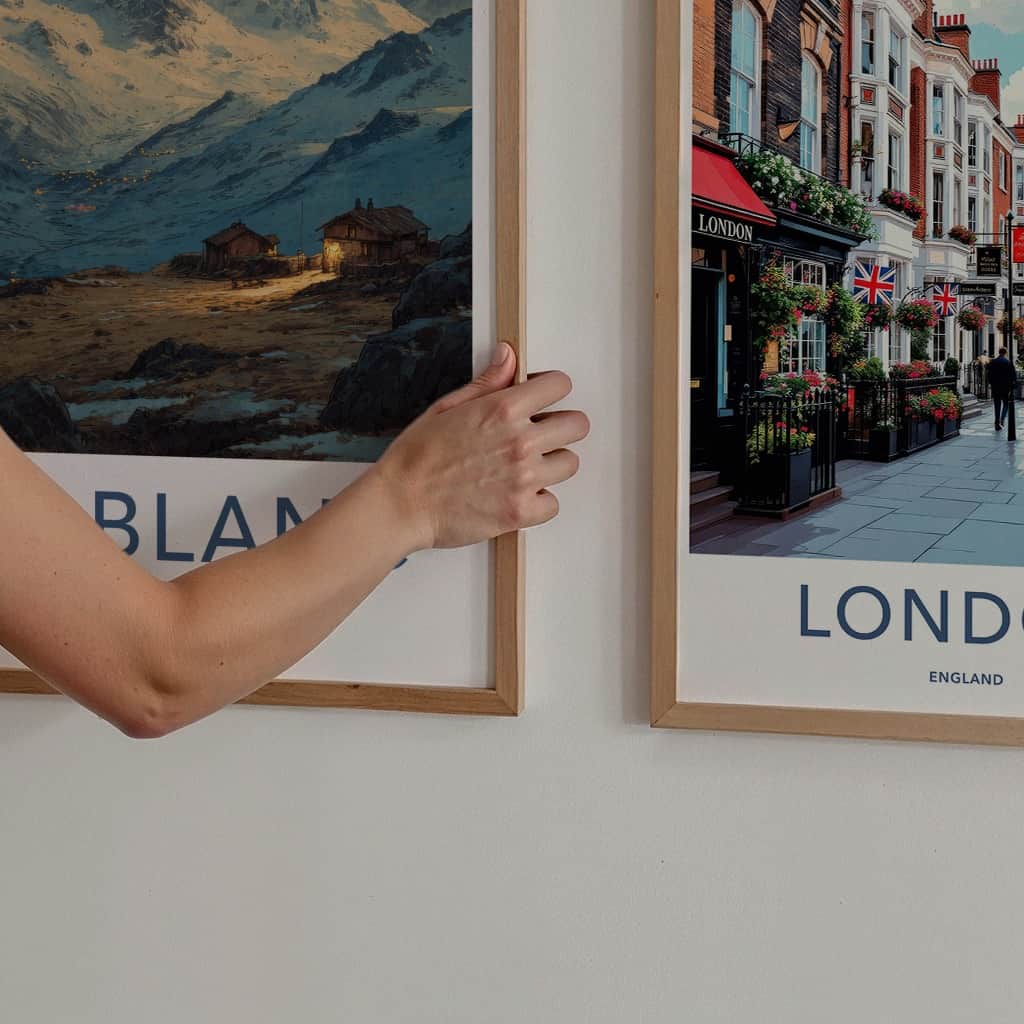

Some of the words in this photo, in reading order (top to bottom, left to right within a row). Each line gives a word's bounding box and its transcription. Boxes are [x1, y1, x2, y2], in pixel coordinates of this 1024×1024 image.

[699, 213, 752, 242] LONDON
[800, 584, 1024, 644] LOND
[929, 671, 1004, 686] ENGLAND
